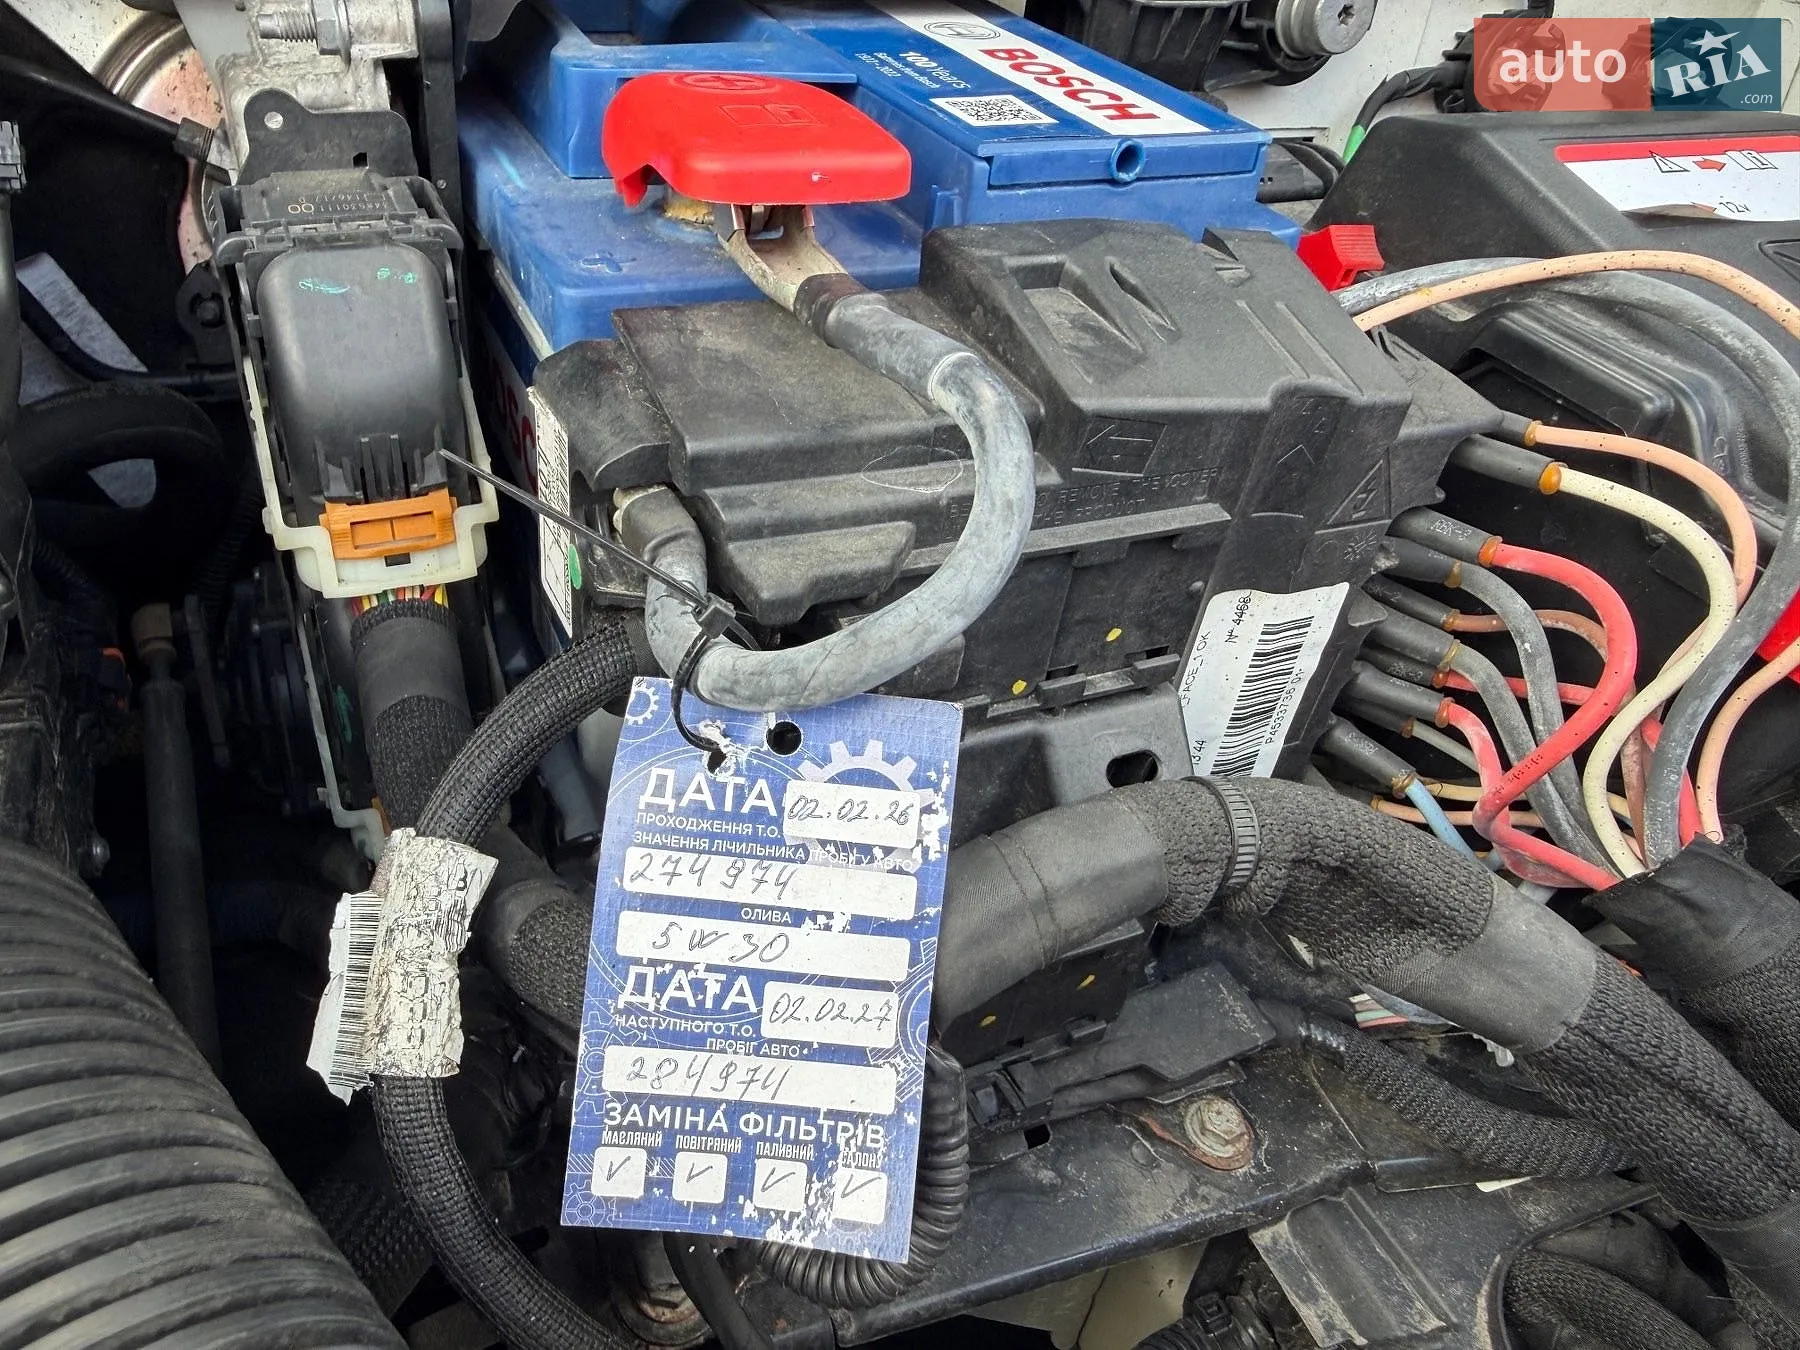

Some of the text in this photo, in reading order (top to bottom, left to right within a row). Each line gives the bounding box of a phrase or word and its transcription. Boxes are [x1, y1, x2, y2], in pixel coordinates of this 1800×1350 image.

[898, 51, 972, 90] 100 Years
[977, 48, 1161, 121] BOSCH
[638, 767, 778, 817] ДАТА
[787, 795, 912, 825] 02.02.26
[636, 812, 782, 839] ПРОХОДЖЕННЯ Т.О.
[633, 831, 709, 851] ЗНАЧЕННЯ
[713, 839, 805, 861] ЛІЧИЛЬНИКА
[741, 907, 791, 924] ОЛИВА
[618, 965, 757, 1013] ДАТА
[615, 1015, 756, 1037] НАСТУПНОГО Т.О.
[768, 992, 894, 1031] 02.02.27
[707, 1038, 800, 1057] ПРОБІГ АВТО
[602, 1130, 663, 1147] МАСЛЯНИЙ
[603, 1102, 887, 1149] ЗАМІНА ФІЛЬТРІВ
[676, 1134, 742, 1153] ПОВІТРЯНИЙ
[756, 1141, 815, 1161] ПАЛИВНИЙ
